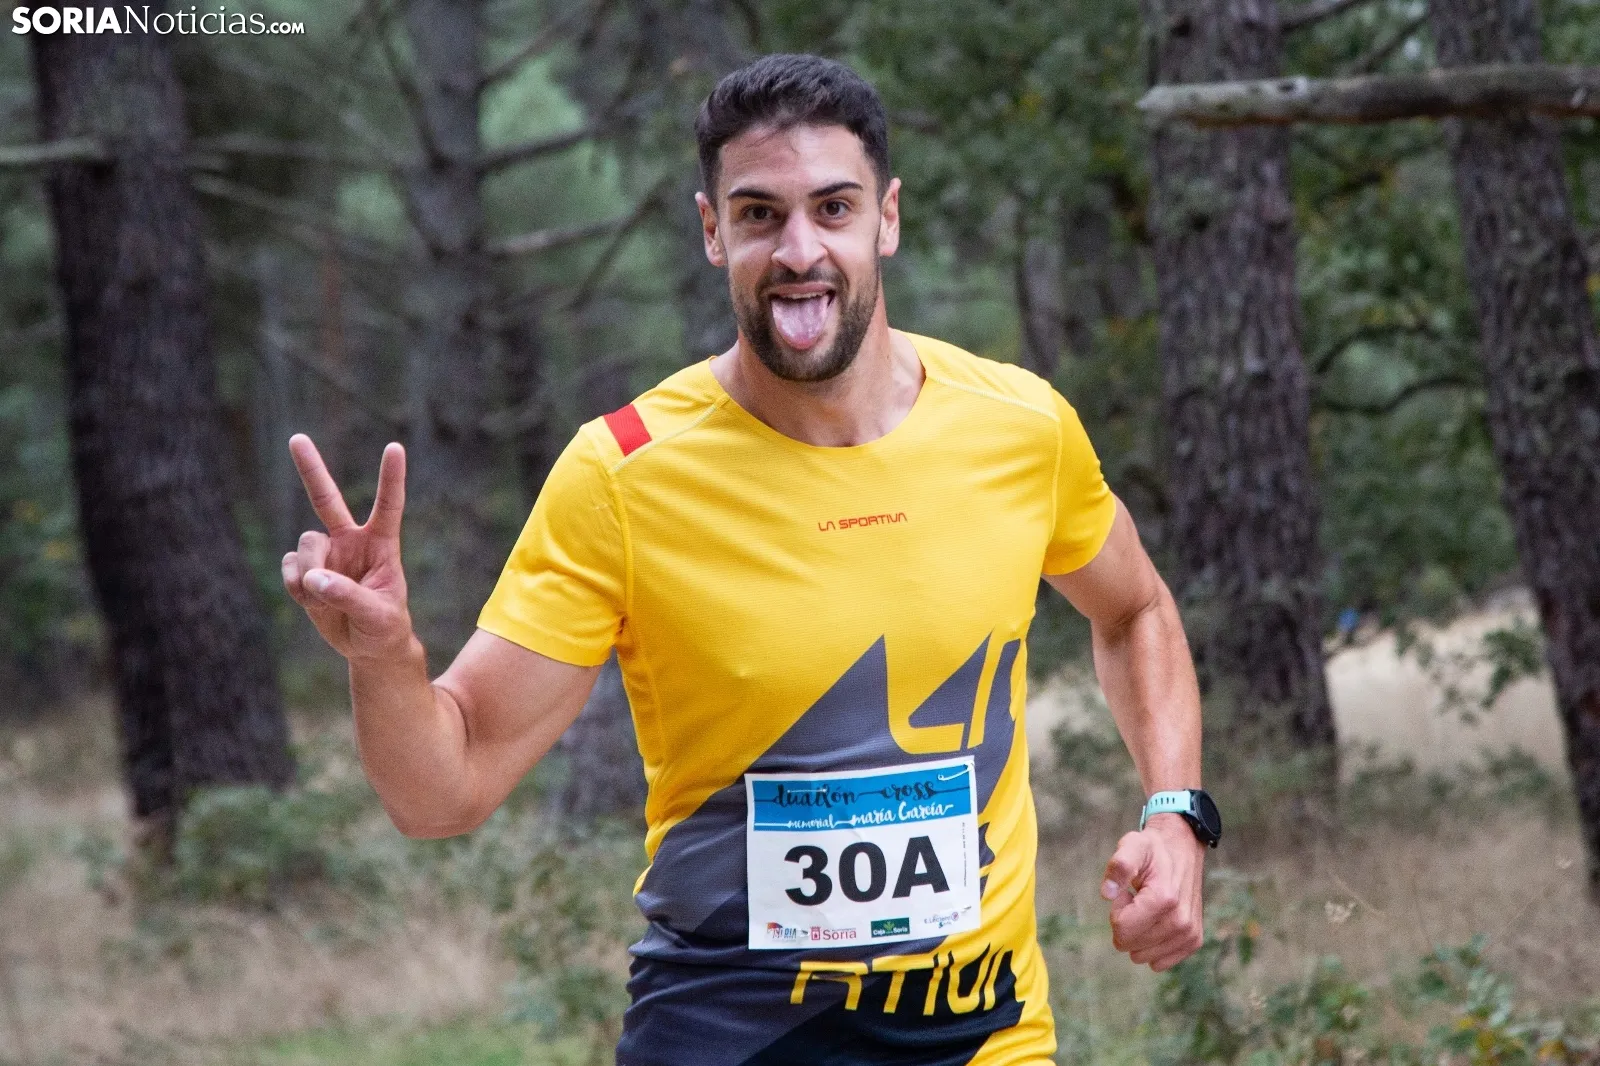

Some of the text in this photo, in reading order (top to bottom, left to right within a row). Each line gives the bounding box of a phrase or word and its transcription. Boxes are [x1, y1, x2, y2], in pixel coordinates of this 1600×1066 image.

[817, 512, 908, 532] LA SPORTIVA
[880, 781, 937, 803] cross
[786, 816, 836, 830] memorial
[898, 801, 954, 820] García
[784, 835, 951, 906] 30A
[823, 928, 857, 941] Soria
